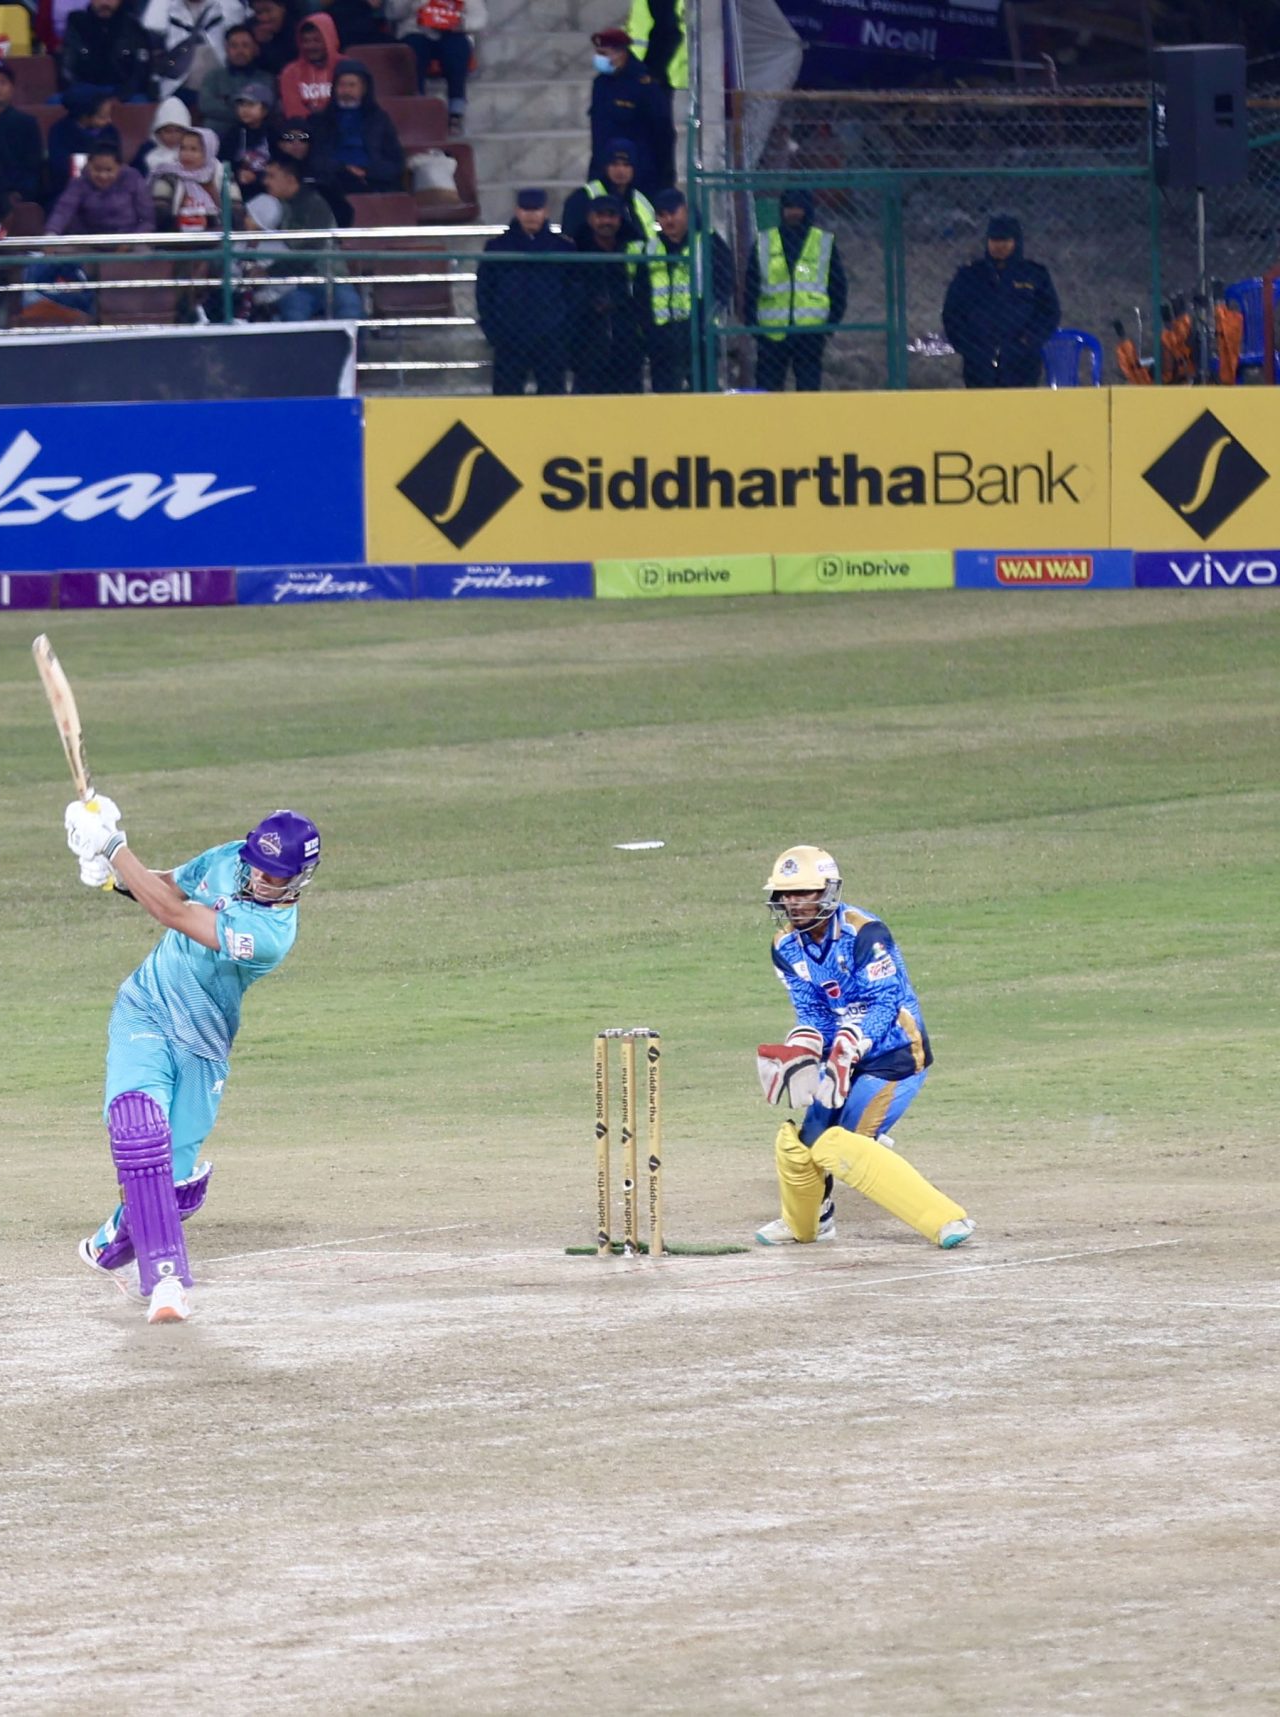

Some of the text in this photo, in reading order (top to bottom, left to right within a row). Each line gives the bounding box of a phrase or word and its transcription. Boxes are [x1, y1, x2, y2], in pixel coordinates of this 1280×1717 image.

[861, 18, 938, 52] Ncell
[667, 567, 730, 584] inDrive
[847, 559, 910, 576] inDrive
[1000, 560, 1088, 579] WAI WAI
[1169, 553, 1278, 585] vivo
[99, 572, 192, 604] Ncell
[649, 1066, 657, 1122] Siddhartha
[624, 1190, 632, 1236] Siddhart
